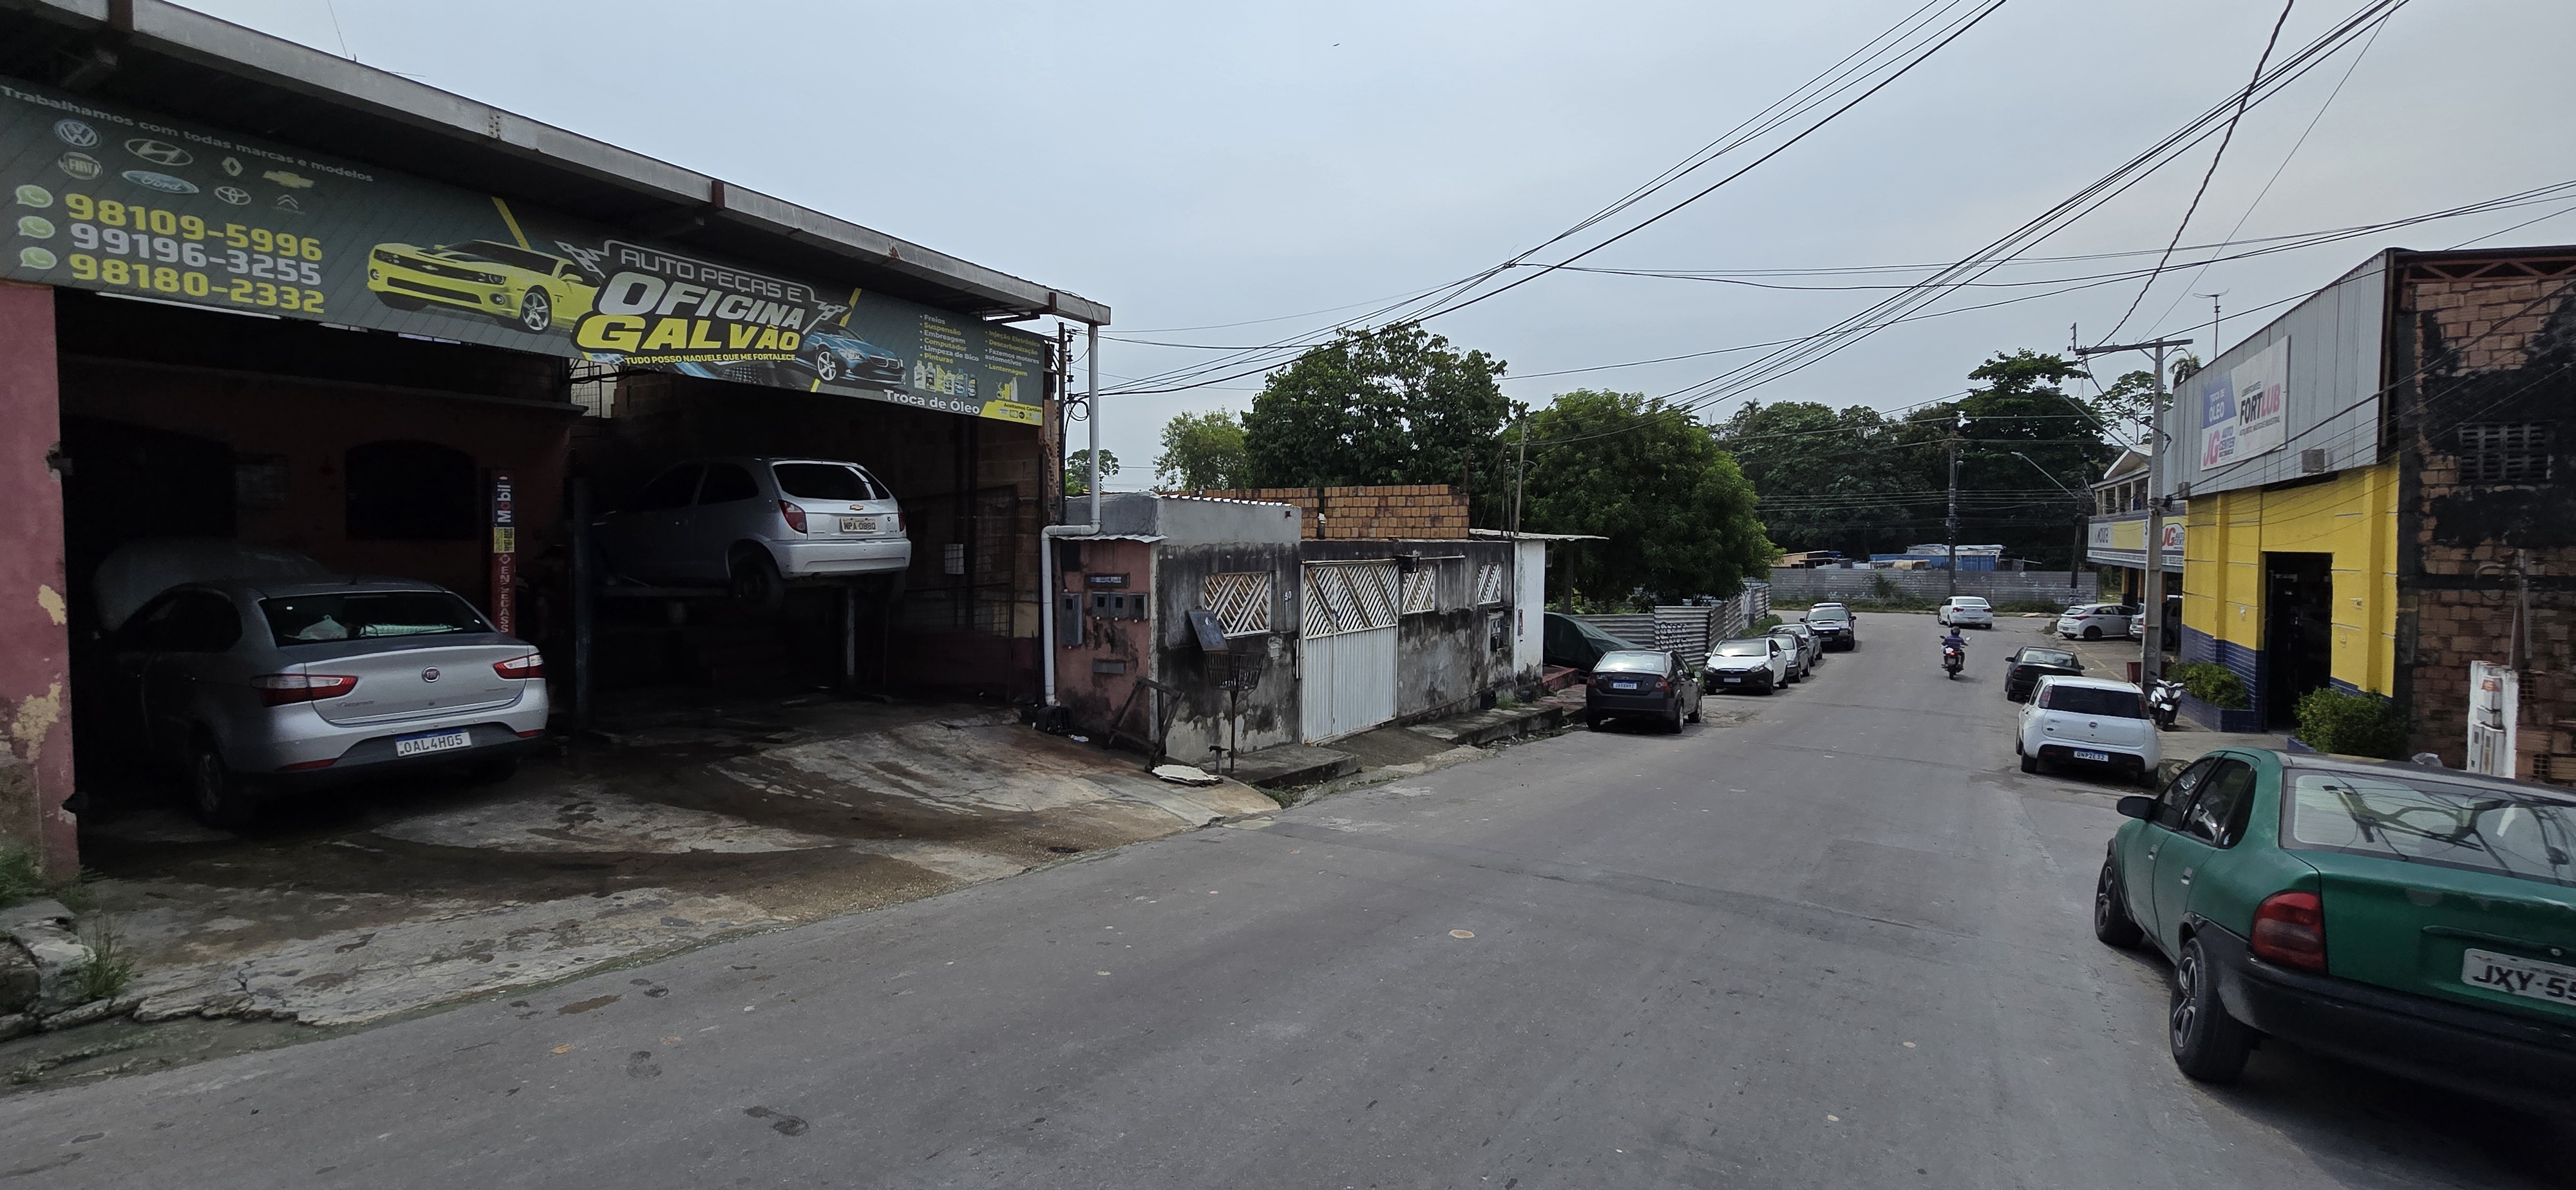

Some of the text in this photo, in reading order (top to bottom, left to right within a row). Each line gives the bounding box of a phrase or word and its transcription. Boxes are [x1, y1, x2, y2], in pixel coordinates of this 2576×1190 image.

[0, 85, 374, 182] Trabalhamos com todas marcas e modelos
[65, 193, 322, 261] 98109-5996
[70, 223, 321, 285] 99196-3255
[70, 254, 325, 314] 98180-2332
[621, 249, 802, 303] AUTO PEÇAS E
[598, 271, 806, 330] OFICINA
[924, 314, 945, 325] Freios
[924, 322, 961, 335] Suspensão
[577, 314, 801, 353] GALVÃO
[924, 330, 966, 345] Embreagem
[989, 330, 1011, 342] Injeção
[924, 337, 967, 352] Computador
[924, 345, 979, 362] Limpeza de Bico
[989, 339, 1038, 355] Descarbonização
[625, 357, 650, 365] TUDO
[652, 355, 683, 364] POSSO
[683, 354, 722, 363] NAQUELE
[723, 354, 739, 362] QUE
[753, 353, 796, 362] FORTALECE
[924, 352, 953, 364] Pinturas
[985, 354, 1022, 367] automotivos
[989, 348, 1039, 364] Fazemos motores
[989, 363, 1028, 377] Lanternagem
[884, 389, 925, 408] Troca
[929, 397, 947, 410] de
[950, 398, 981, 415] Óleo
[1003, 402, 1026, 411] Aceitamos
[2239, 382, 2281, 426] FORTLUB
[2203, 430, 2220, 466] JG
[497, 484, 511, 523] Mobil
[500, 566, 510, 633] ENECASS
[404, 734, 463, 753] OAL4H05
